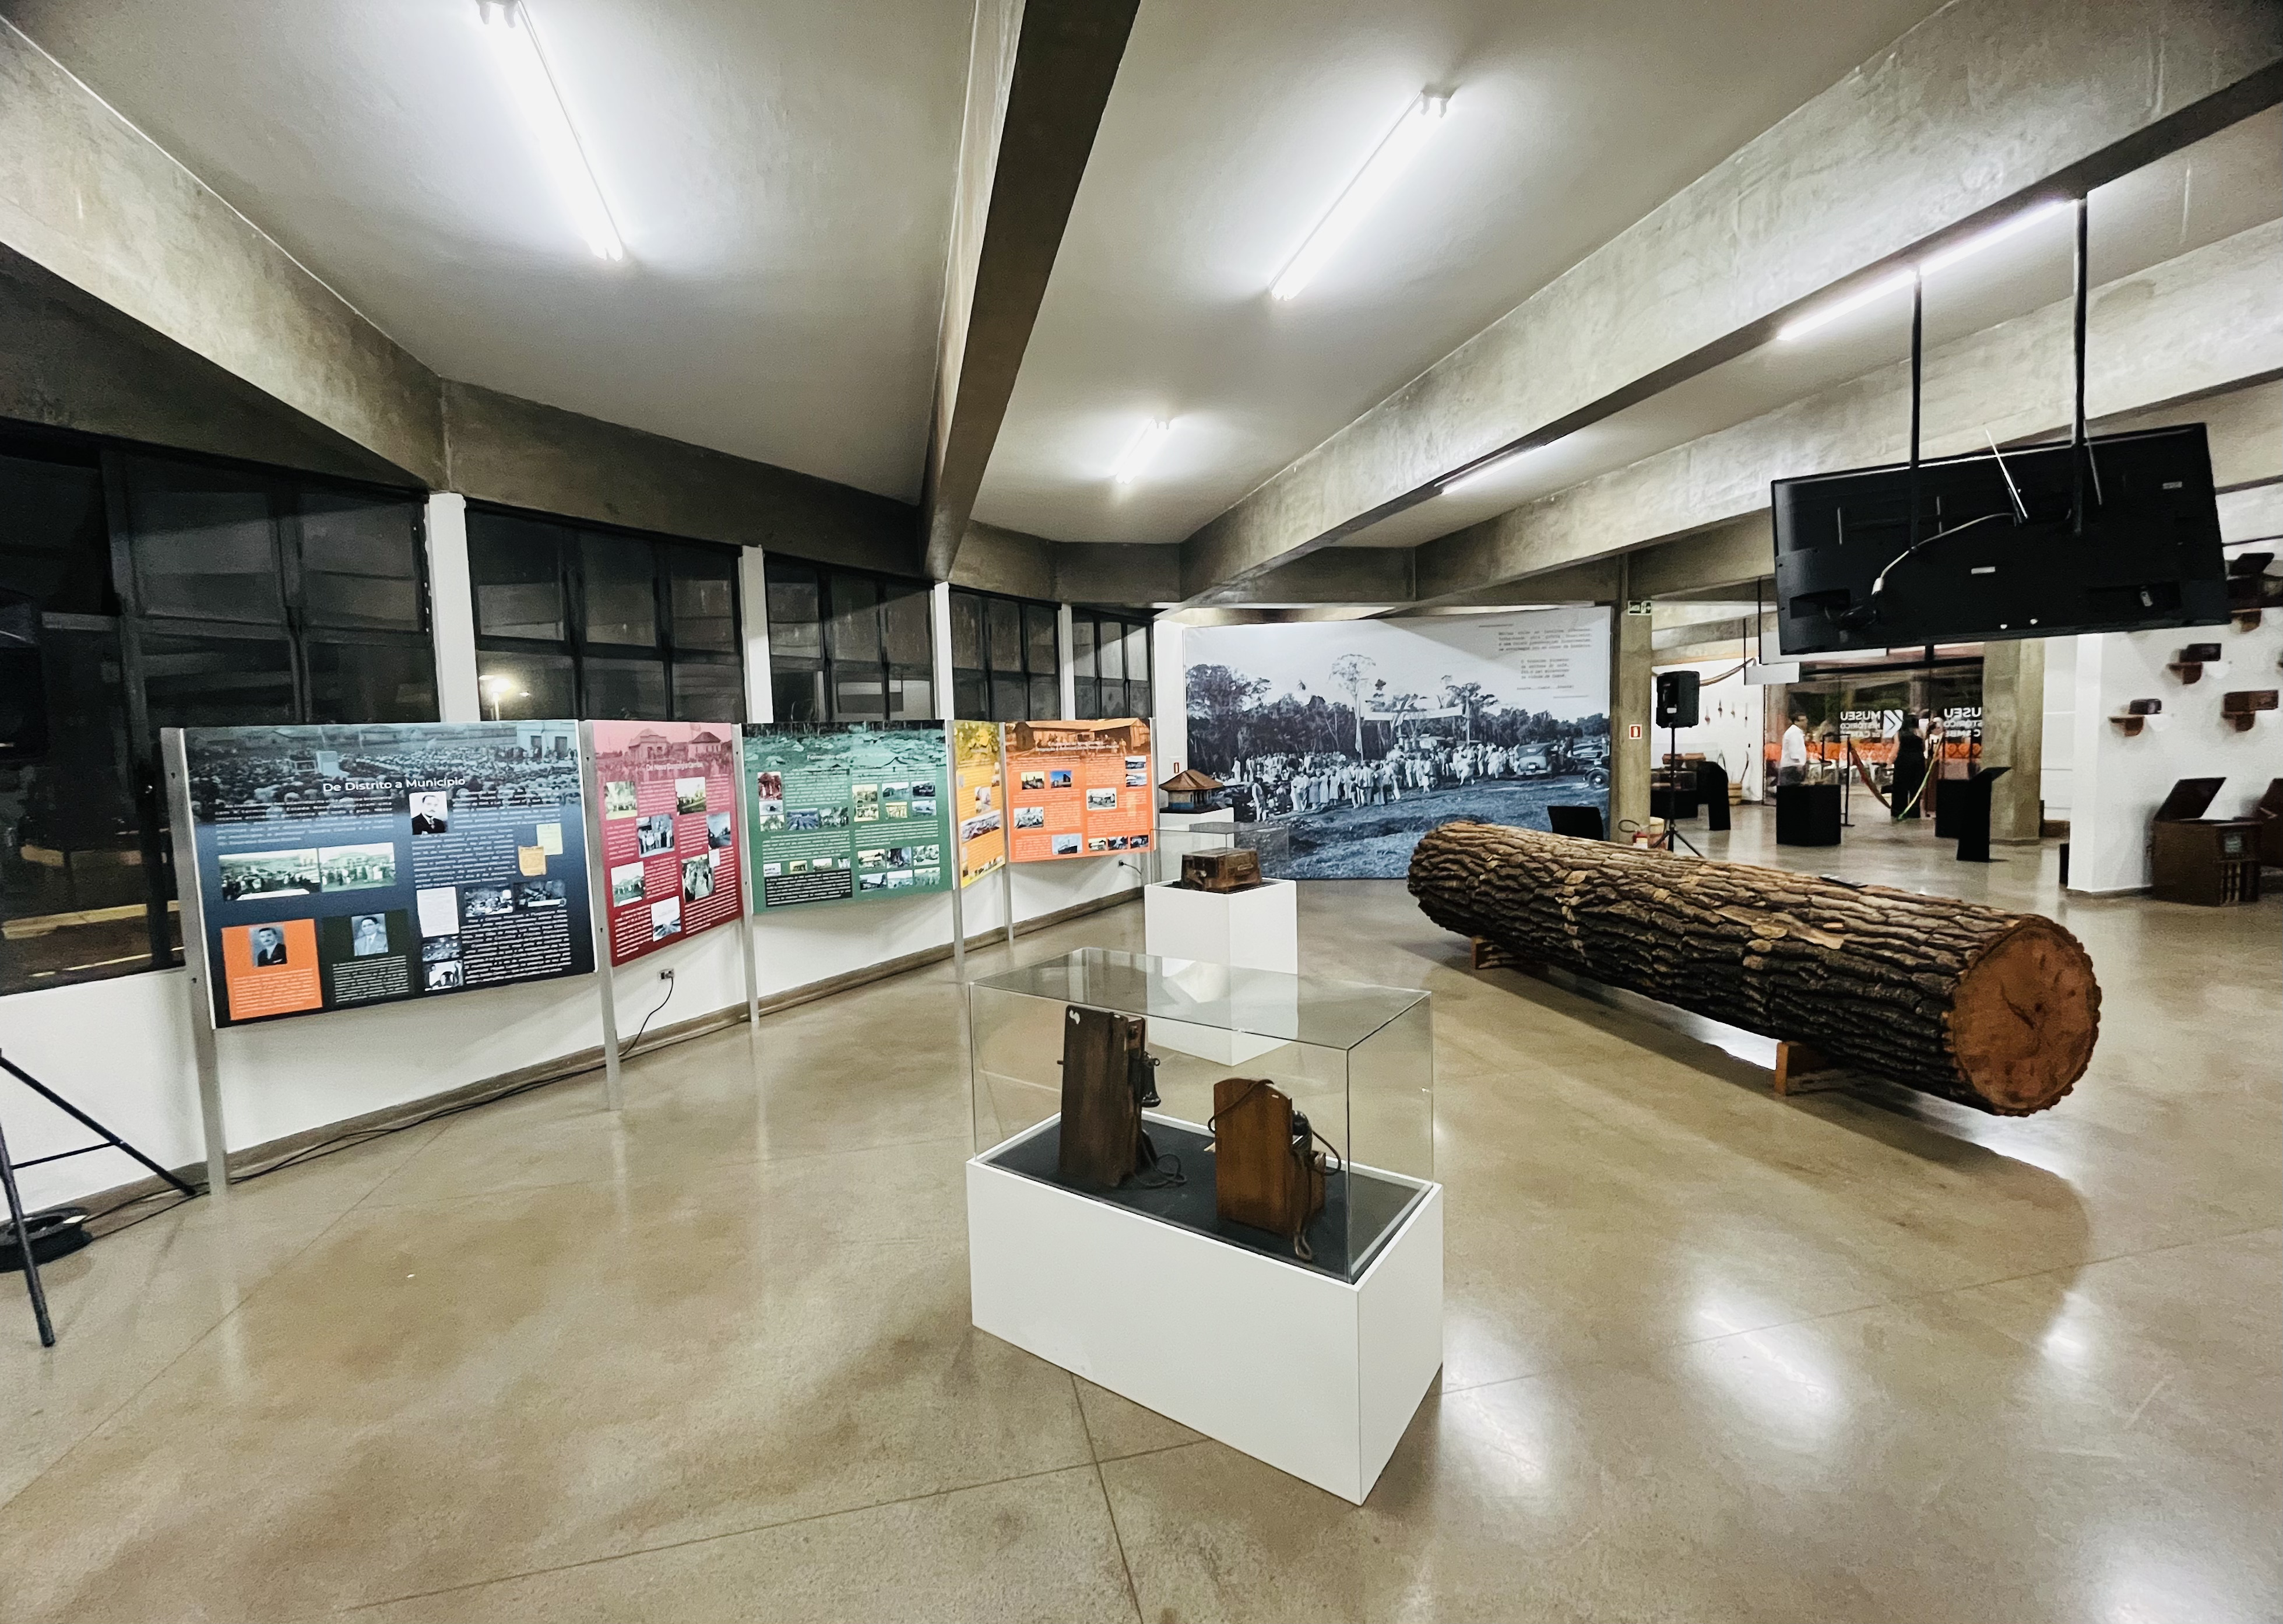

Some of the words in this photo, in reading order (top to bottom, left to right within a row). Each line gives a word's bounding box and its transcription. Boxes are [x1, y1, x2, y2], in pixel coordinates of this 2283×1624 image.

[322, 783, 342, 792] De
[345, 781, 392, 792] Distrito
[406, 776, 466, 788] Município
